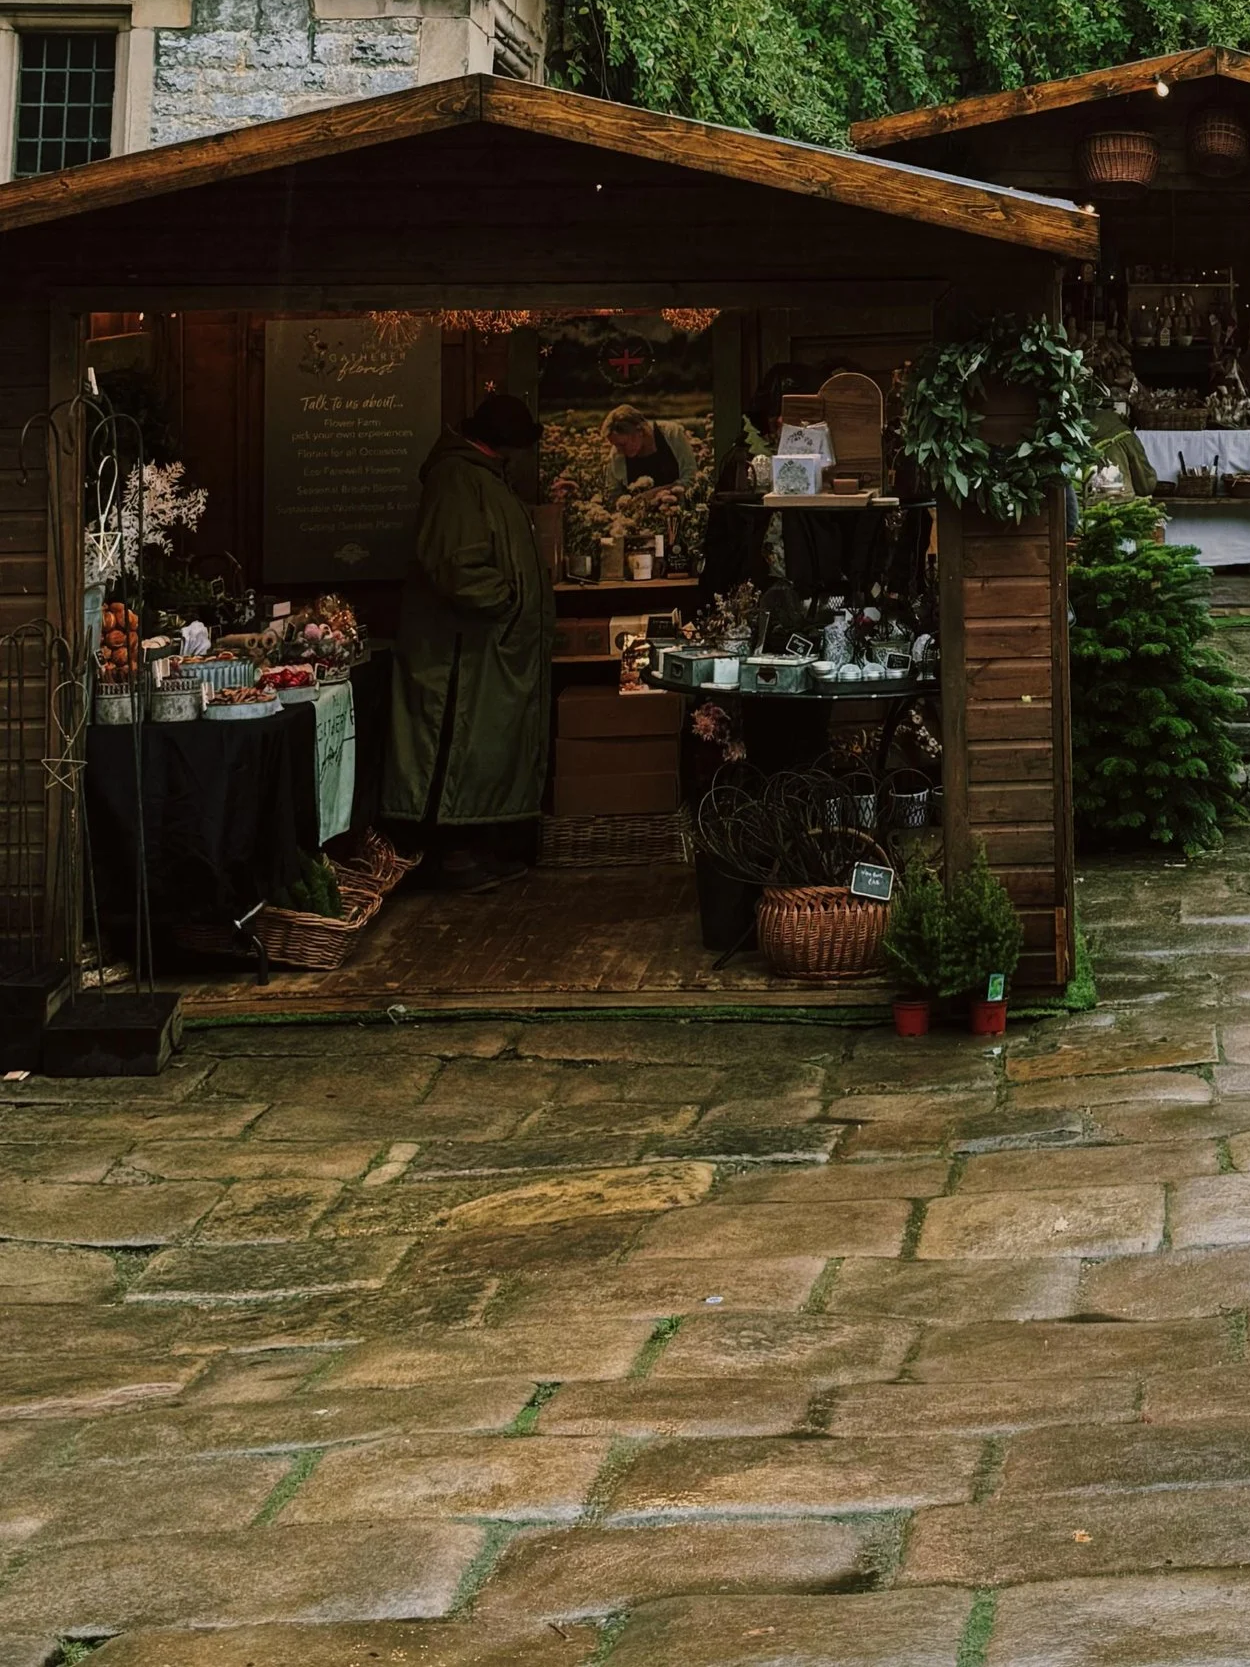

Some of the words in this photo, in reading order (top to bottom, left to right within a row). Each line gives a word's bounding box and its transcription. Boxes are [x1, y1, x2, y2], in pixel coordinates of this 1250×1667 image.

[328, 352, 405, 363] GATHERER
[336, 361, 403, 382] florist
[299, 393, 328, 412] Talk
[328, 396, 343, 411] to
[345, 398, 359, 410] us
[362, 393, 403, 410] about...
[323, 418, 355, 428] Flower
[357, 417, 380, 427] Farm
[291, 430, 311, 443] pick
[312, 431, 334, 442] your
[357, 429, 413, 440] experiences
[329, 447, 342, 458] for
[344, 446, 356, 457] all
[358, 446, 407, 456] Occasions
